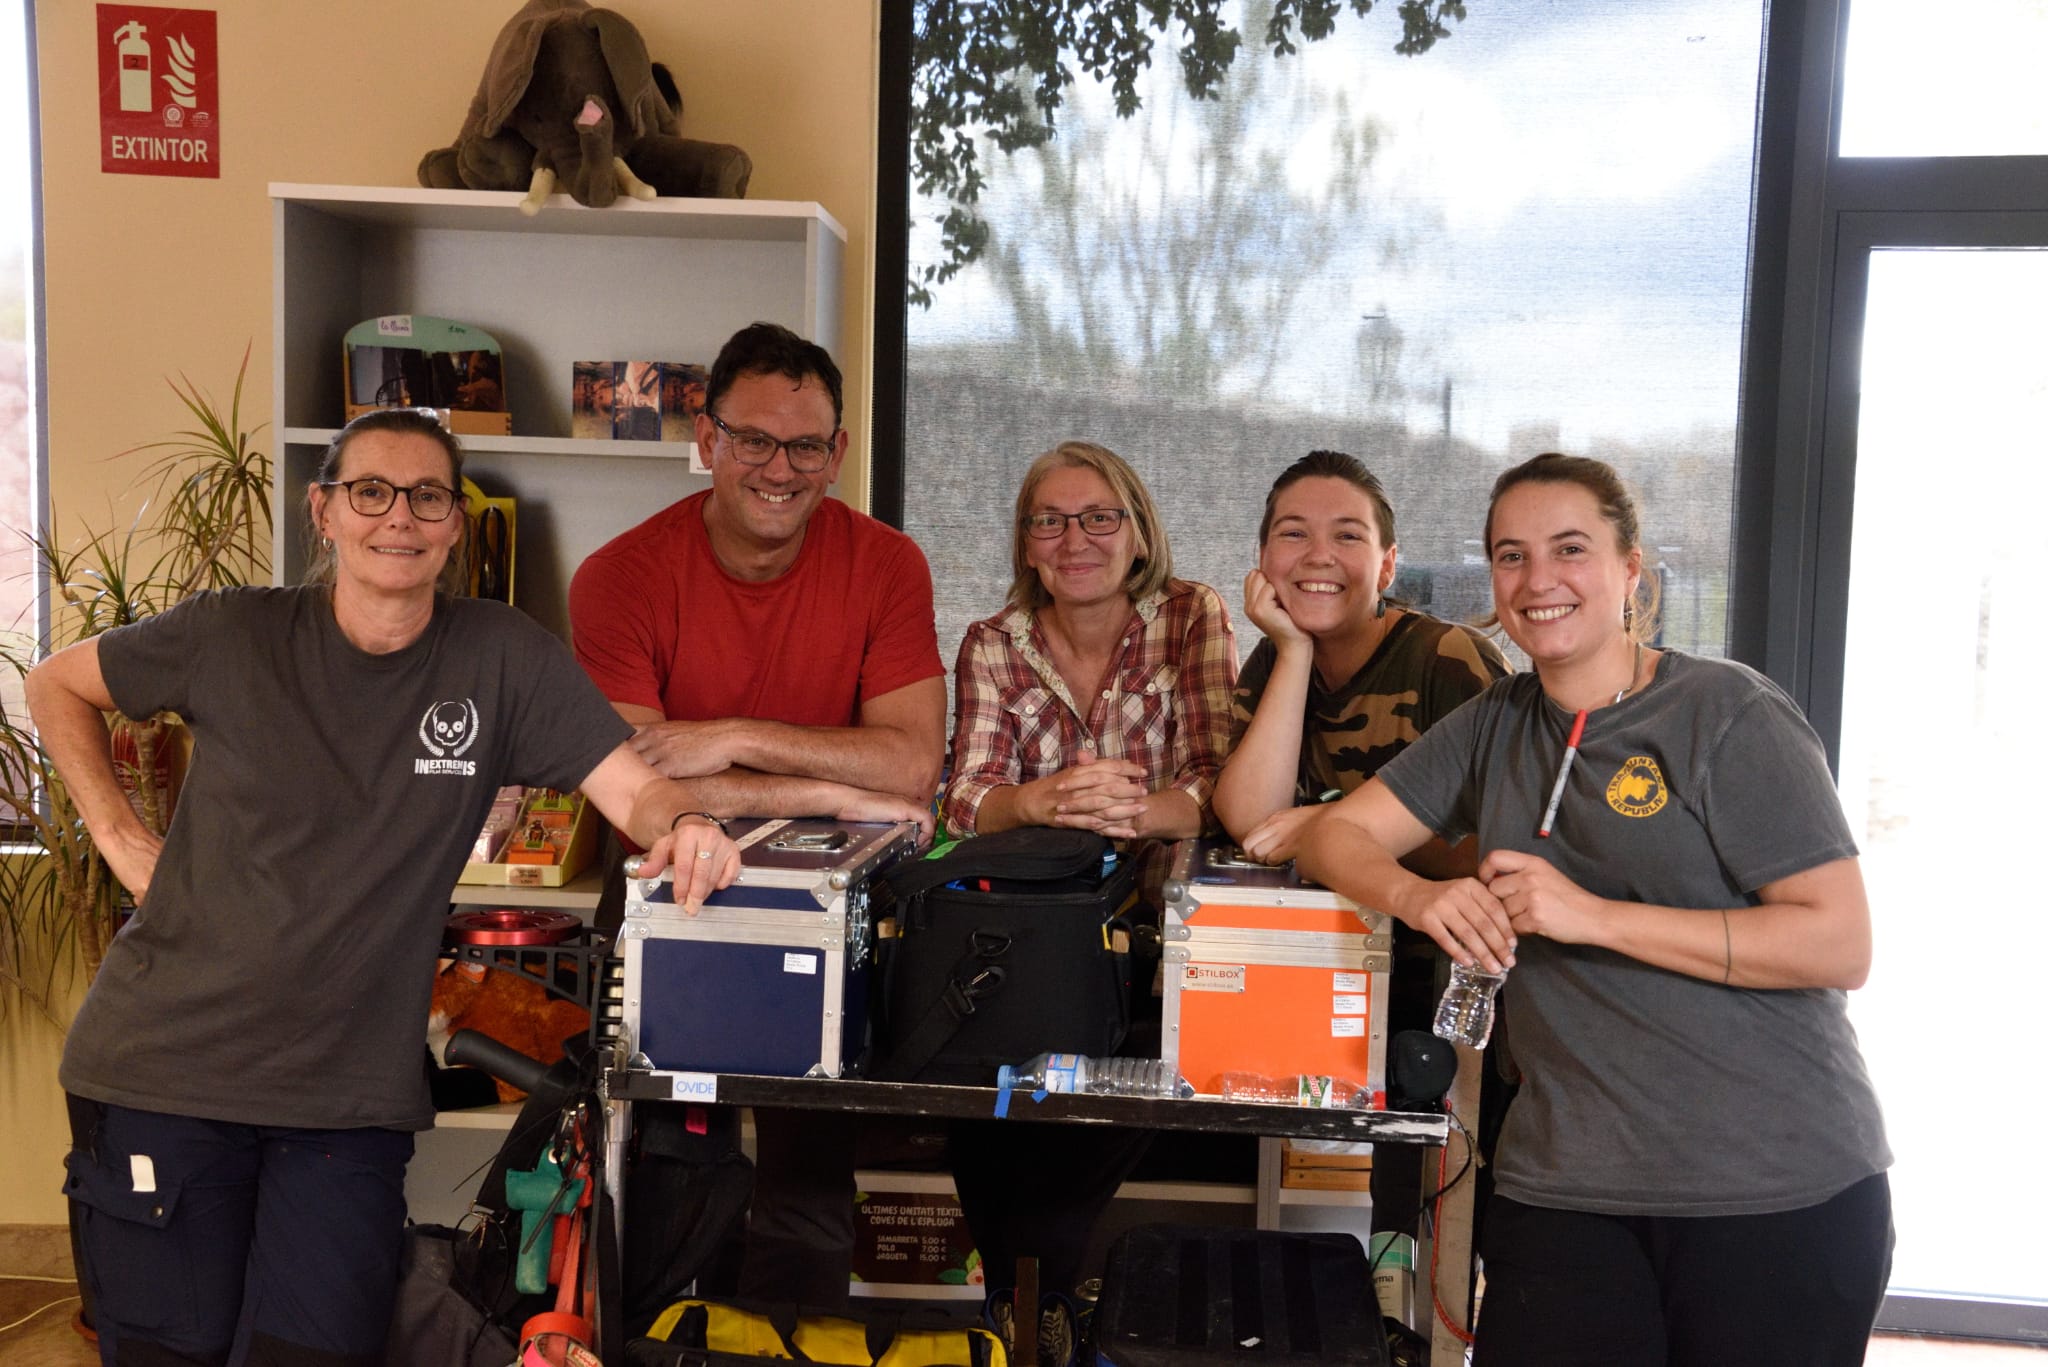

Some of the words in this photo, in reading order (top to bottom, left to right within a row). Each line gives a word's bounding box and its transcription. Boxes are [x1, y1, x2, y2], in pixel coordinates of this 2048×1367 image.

[111, 135, 209, 164] EXTINTOR
[1199, 969, 1240, 979] STILBOX
[676, 1080, 715, 1094] OVIDE
[870, 1216, 896, 1225] COVES
[897, 1217, 908, 1225] DE
[877, 1244, 896, 1252] POLO
